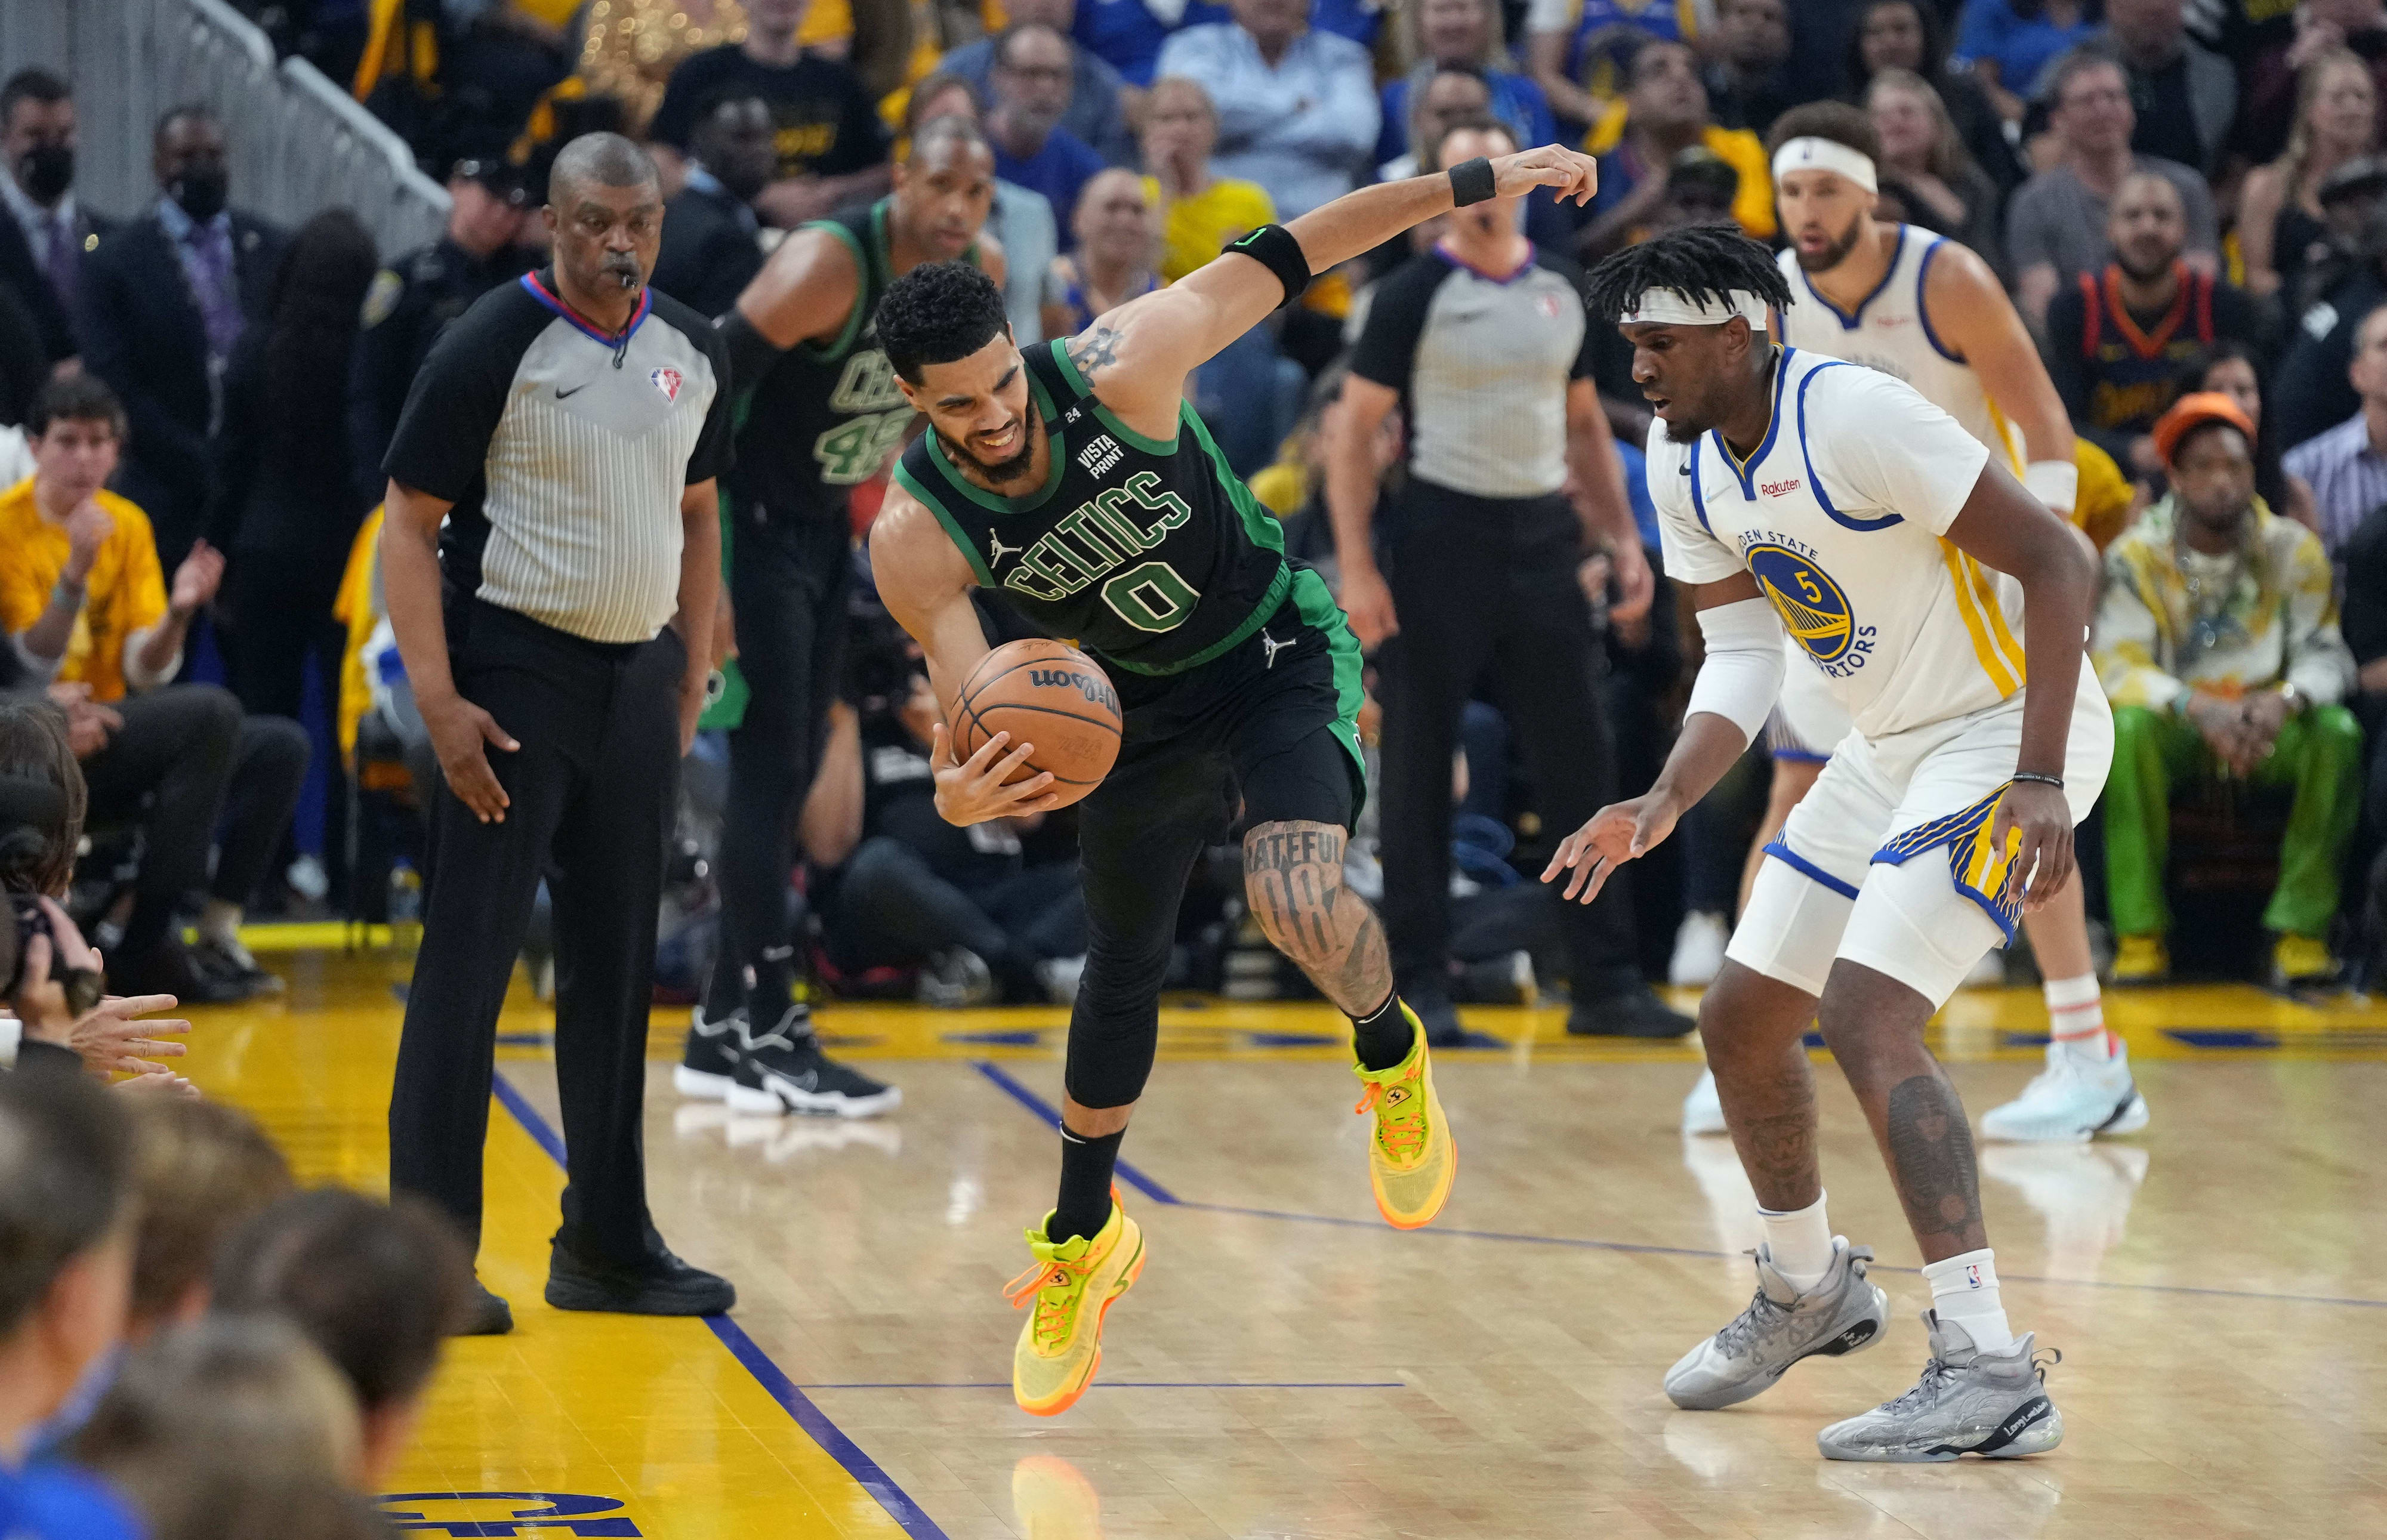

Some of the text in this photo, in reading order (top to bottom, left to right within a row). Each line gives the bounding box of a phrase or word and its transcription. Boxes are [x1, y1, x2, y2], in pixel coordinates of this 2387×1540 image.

[1065, 407, 1082, 423] 24
[1078, 434, 1117, 468] VISTA
[1089, 445, 1124, 480] PRINT
[1762, 479, 1801, 496] Rakuten
[1004, 471, 1192, 601] CELTICS
[1738, 529, 1819, 560] DEN STATE
[1100, 561, 1202, 633] 0
[1794, 570, 1822, 603] 5
[1808, 626, 1877, 678] RIORS
